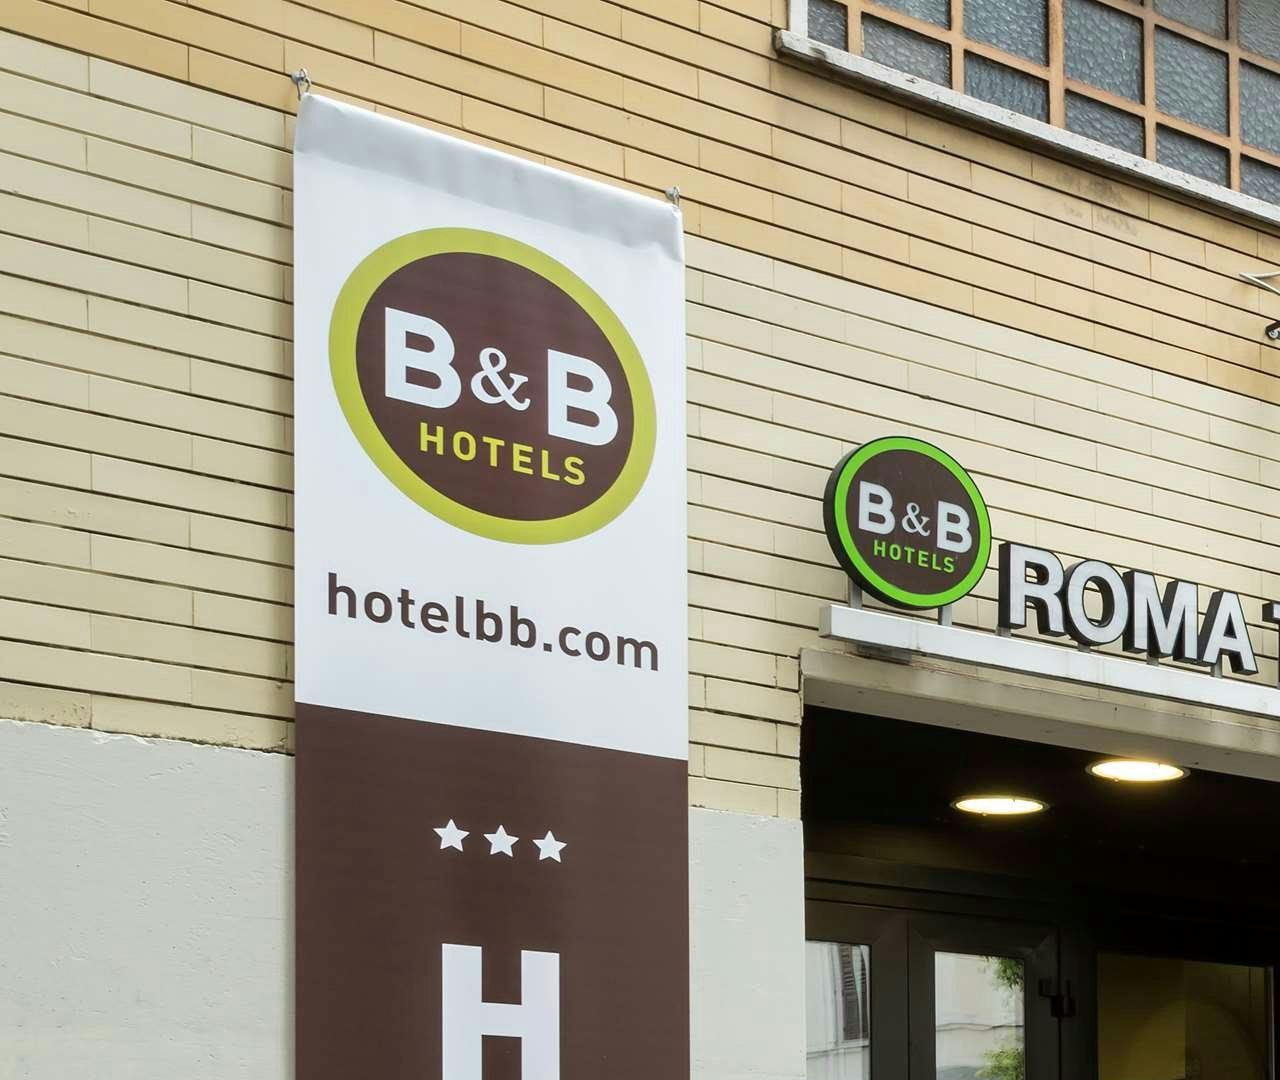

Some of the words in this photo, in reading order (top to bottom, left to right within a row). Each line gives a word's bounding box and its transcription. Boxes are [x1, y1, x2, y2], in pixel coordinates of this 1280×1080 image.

[385, 306, 619, 447] B&B
[419, 422, 586, 486] HOTELS
[858, 480, 973, 554] B&B
[873, 539, 955, 574] HOTELS
[327, 572, 659, 672] hotelbb.com
[1002, 541, 1258, 676] ROMA
